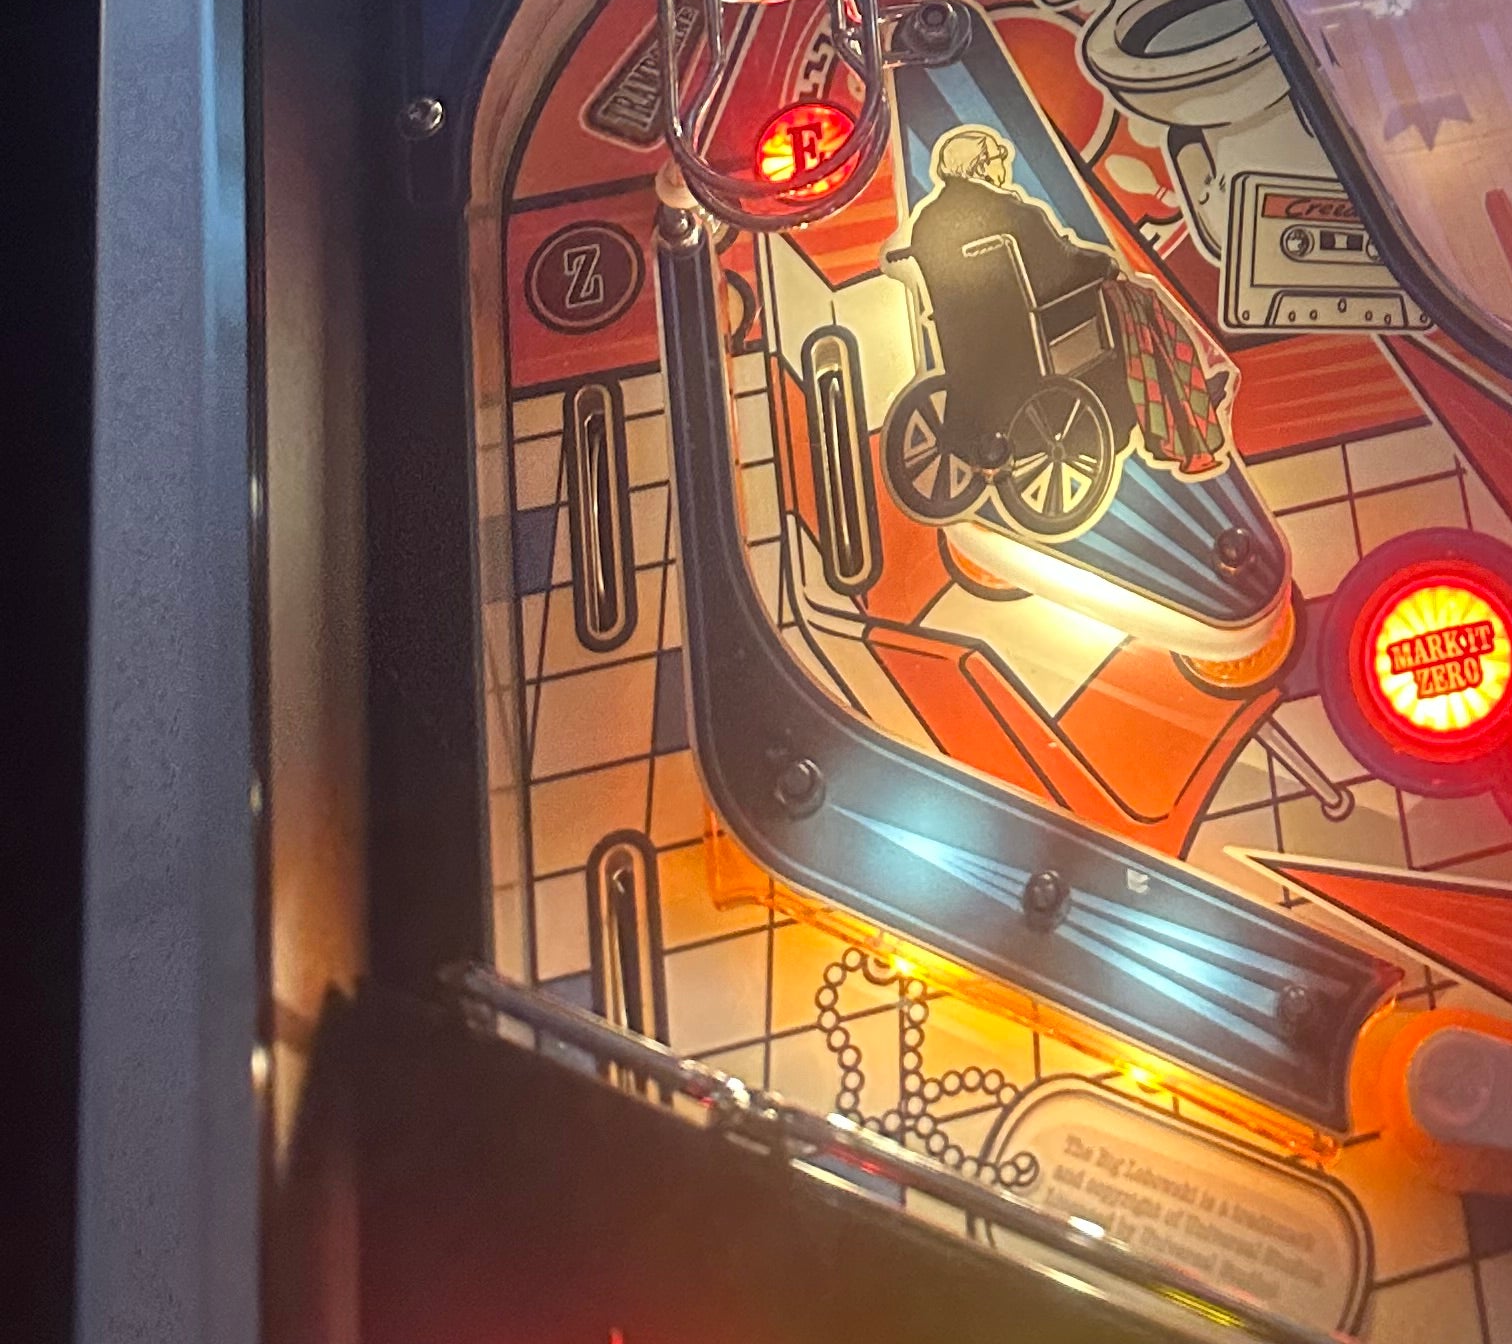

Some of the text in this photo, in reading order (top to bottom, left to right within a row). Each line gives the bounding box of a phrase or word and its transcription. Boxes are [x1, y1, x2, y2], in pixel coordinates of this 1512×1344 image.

[563, 243, 604, 309] Z
[1390, 623, 1492, 671] MARK IT
[1415, 656, 1481, 698] ZERO
